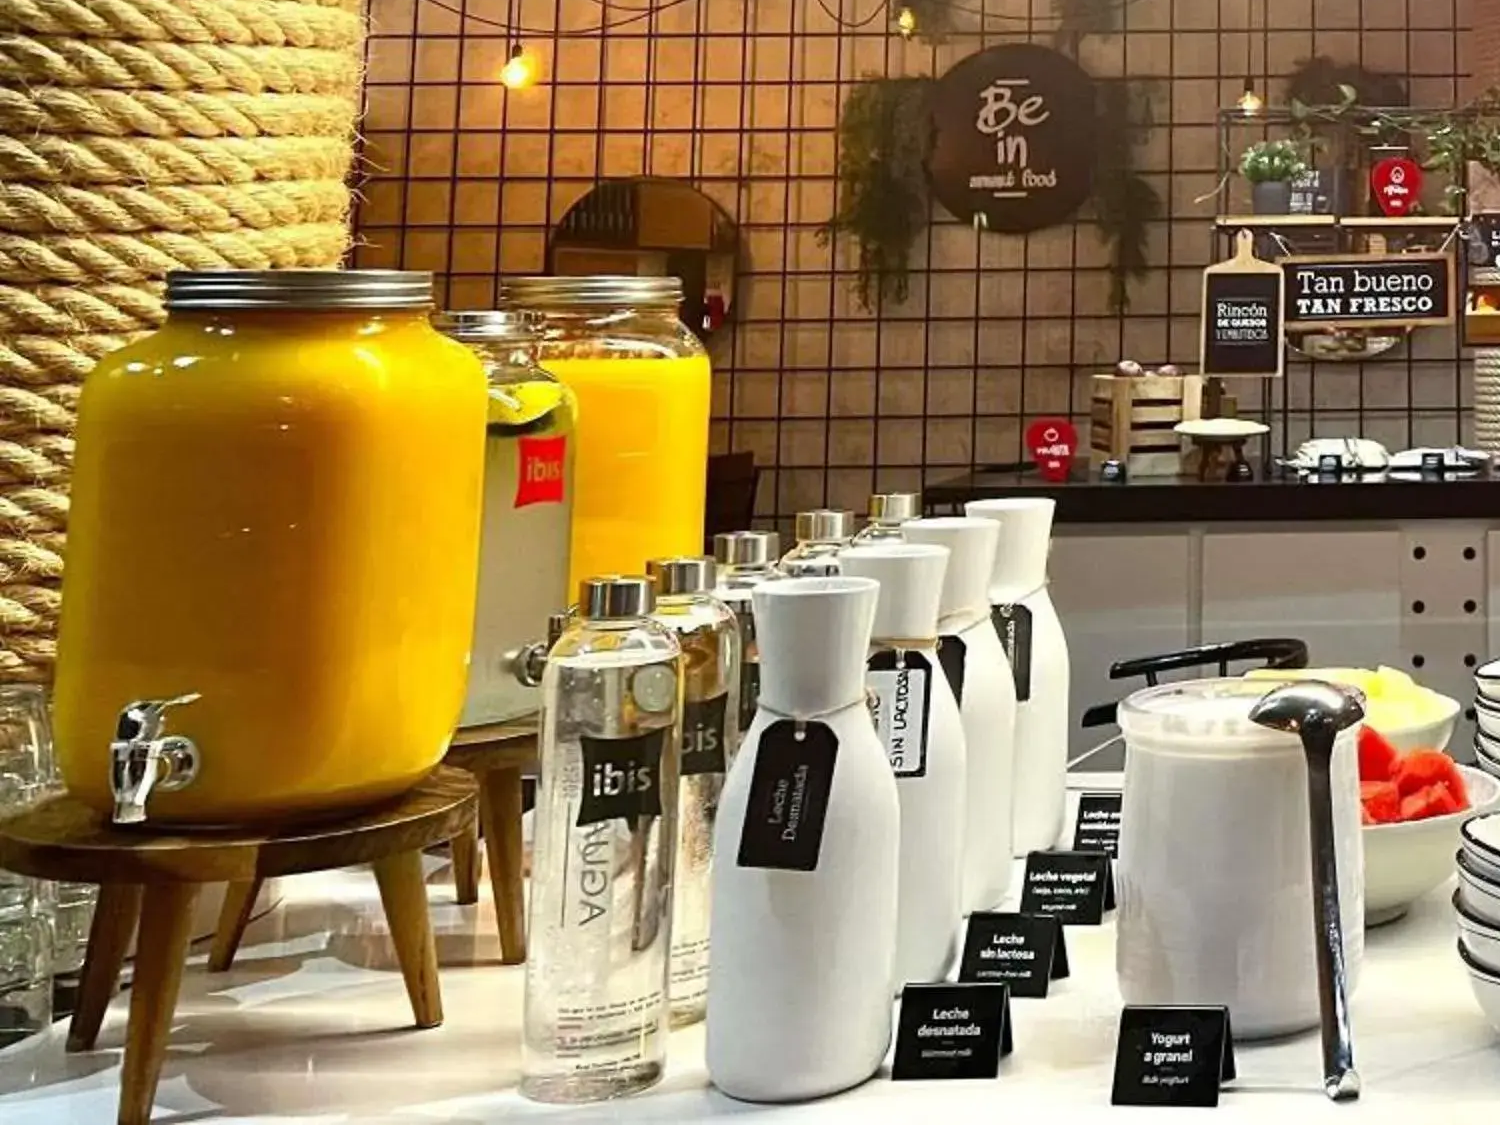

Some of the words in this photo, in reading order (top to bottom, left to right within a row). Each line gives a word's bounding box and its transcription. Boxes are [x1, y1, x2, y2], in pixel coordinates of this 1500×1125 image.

[976, 85, 1050, 135] Be
[996, 132, 1028, 168] in
[1021, 168, 1057, 188] food
[1297, 271, 1345, 294] Tan
[1353, 271, 1433, 293] bueno
[1217, 302, 1268, 318] Rincón
[1297, 298, 1341, 314] TAN
[1349, 296, 1433, 313] FRESCO
[526, 456, 562, 483] ibis
[682, 722, 718, 754] is
[890, 738, 904, 768] SIN
[593, 760, 652, 797] ibis
[767, 778, 790, 824] Leche
[1029, 870, 1059, 882] Leche
[1060, 871, 1097, 884] vegetal
[993, 932, 1025, 945] Leche
[997, 947, 1035, 960] lactosa
[933, 1006, 969, 1020] Leche
[917, 1023, 981, 1037] desnatada
[1151, 1032, 1190, 1048] Yogurt
[1143, 1052, 1152, 1063] a
[1153, 1049, 1193, 1066] granel
